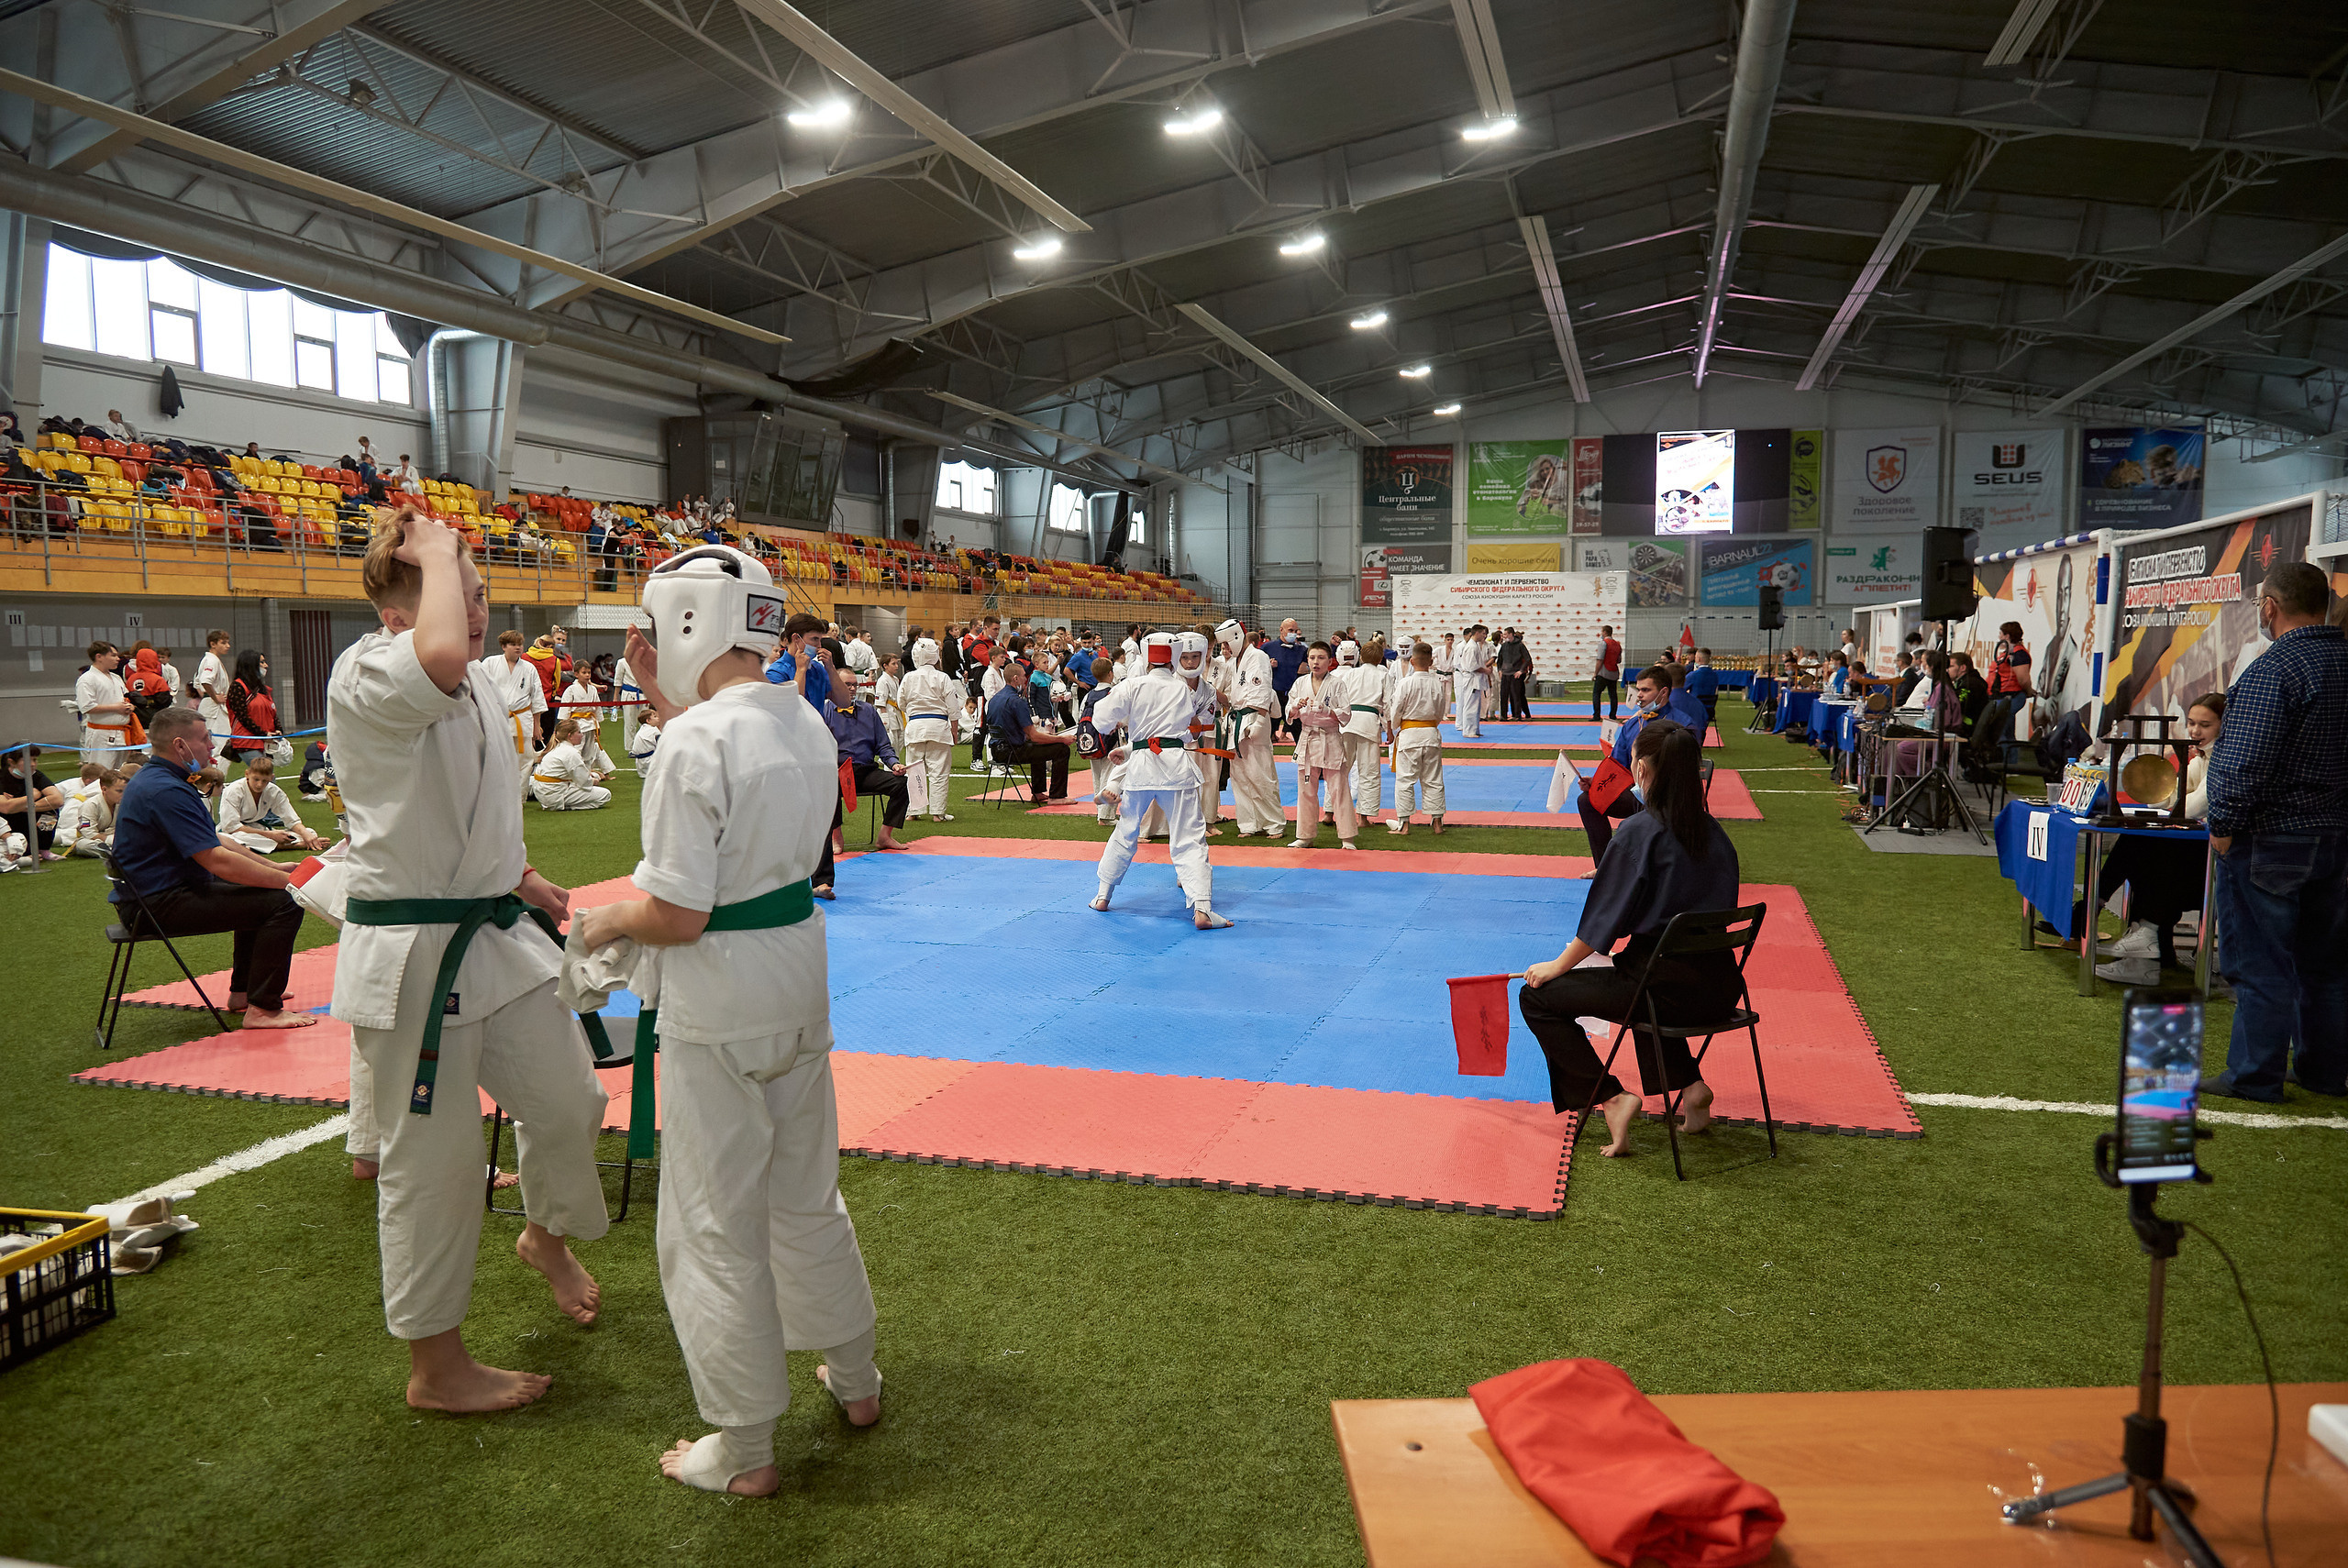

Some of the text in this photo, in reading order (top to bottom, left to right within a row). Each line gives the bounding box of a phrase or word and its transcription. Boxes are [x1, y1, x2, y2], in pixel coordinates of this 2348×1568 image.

[1974, 471, 2043, 485] SEUS
[1379, 495, 1436, 505] Центральные
[1857, 496, 1912, 506] Здоровое
[1853, 506, 1916, 516] поколение
[1471, 557, 1497, 565] Очень
[1498, 557, 1534, 566] хорошие
[1709, 547, 1762, 567] BARNAUL
[1411, 563, 1445, 571] ЗНАЧЕНИЕ
[1835, 574, 1921, 584] РАЗДРАКОНИ
[1853, 584, 1911, 592] АППЕТИТ!
[8, 614, 22, 624] III
[129, 616, 140, 626] IV
[2032, 826, 2044, 856] IV
